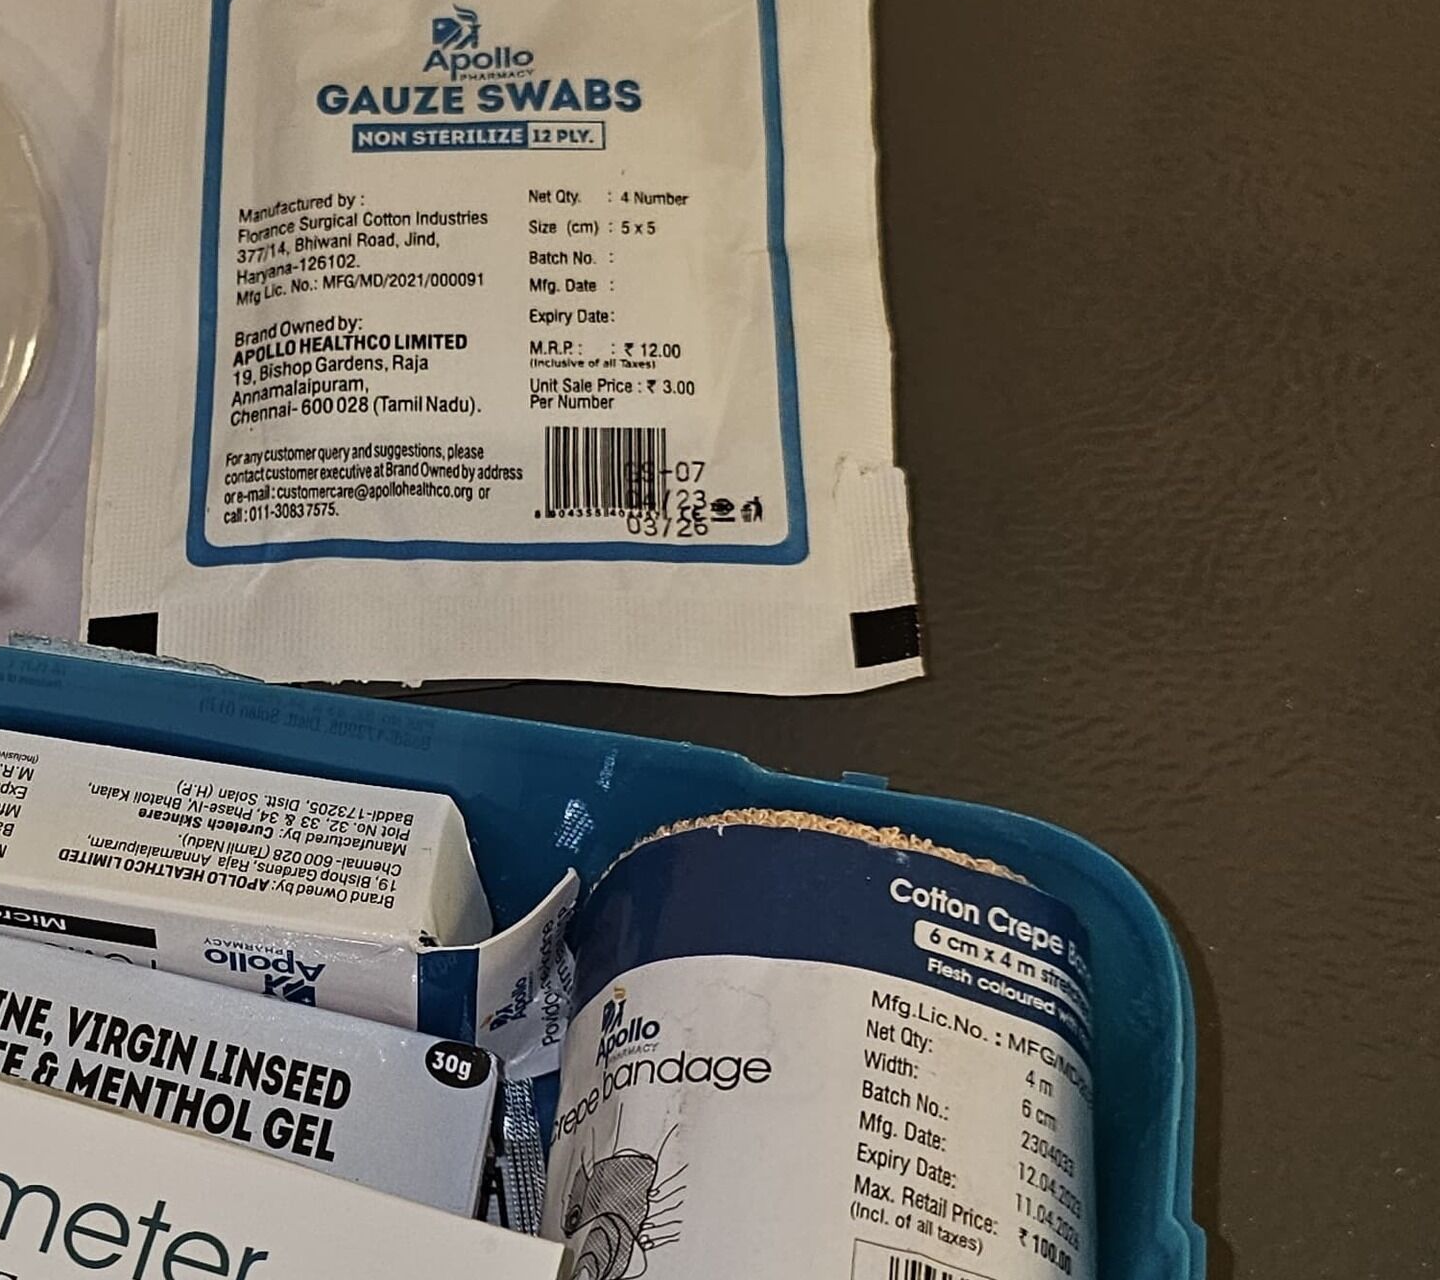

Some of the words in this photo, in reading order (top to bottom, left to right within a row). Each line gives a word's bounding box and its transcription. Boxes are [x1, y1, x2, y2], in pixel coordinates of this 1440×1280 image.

[423, 46, 534, 81] Apollo
[460, 69, 535, 81] PHARMACY
[316, 84, 464, 115] GAUZE
[477, 79, 642, 112] SWABS
[358, 130, 407, 147] NON
[412, 128, 524, 145] STERILIZE
[238, 194, 332, 223] Manufactured
[337, 193, 355, 209] by
[528, 189, 551, 203] Net
[634, 192, 689, 206] Number
[238, 222, 295, 243] Florance
[299, 213, 357, 231] Surgical
[362, 212, 411, 226] Cotton
[416, 210, 488, 226] Industries
[528, 220, 557, 234] Size
[567, 219, 599, 236] (cm)
[621, 221, 630, 234] 5
[647, 221, 656, 235] 5
[404, 232, 440, 248] Jind,
[529, 250, 568, 265] Batch
[323, 273, 484, 289] MFG/MD/2021/000091
[529, 279, 560, 294] Mfg.
[565, 279, 596, 292] Date
[529, 308, 572, 325] Expiry
[235, 325, 277, 347] Brand
[280, 316, 335, 337] Owned
[233, 339, 295, 367] APOLLO
[300, 334, 390, 353] HEALTHCO
[395, 334, 468, 350] LIMITED
[641, 343, 681, 358] 12.00
[260, 359, 311, 381] Bishop
[315, 355, 388, 373] Gardens,
[392, 355, 428, 373] Raja
[530, 378, 557, 393] Unit
[562, 378, 592, 393] Sale
[597, 379, 633, 393] Price
[663, 380, 695, 396] 3.00
[530, 395, 554, 410] Per
[558, 395, 615, 410] Number
[264, 447, 317, 462] customer
[386, 463, 419, 478] Brand
[421, 462, 459, 479] Owned
[461, 465, 476, 482] by
[477, 465, 523, 480] address
[218, 786, 259, 804] Solan
[138, 808, 202, 829] Skincare
[205, 818, 274, 839] Curetech
[285, 813, 297, 826] &
[300, 815, 319, 830] 33
[382, 826, 411, 841] Plot
[304, 834, 407, 856] Manufactured
[58, 848, 122, 869] LIMITED
[217, 856, 249, 873] Raja
[124, 856, 205, 883] HEALTHCO
[207, 871, 270, 891] APOLLO
[296, 883, 348, 903] Owned
[350, 888, 395, 908] Brand
[889, 877, 980, 925] Cotton
[987, 906, 1064, 955] Crepe
[930, 927, 942, 945] 6
[947, 935, 978, 958] cm
[1000, 952, 1012, 967] 4
[204, 945, 327, 982] Apollo
[927, 957, 973, 985] Flesh
[977, 976, 1056, 1016] coloured
[595, 1017, 661, 1068] Apollo
[866, 1019, 895, 1043] Net
[901, 1027, 934, 1053] Qty:
[1025, 1070, 1036, 1087] 4
[68, 1004, 194, 1077] VIRGIN
[202, 1040, 352, 1112] LINSEED
[429, 1048, 474, 1081] 30g
[864, 1049, 919, 1079] Width:
[602, 1050, 772, 1102] bandage
[862, 1080, 911, 1108] Batch
[68, 1059, 253, 1142] MENTHOL
[261, 1112, 336, 1164] GEL
[859, 1111, 897, 1139] Mfg.
[904, 1121, 946, 1152] Date:
[856, 1142, 911, 1175] Expiry
[916, 1157, 957, 1189] Date:
[853, 1174, 895, 1203] Max.
[901, 1186, 947, 1218] Retail
[951, 1203, 999, 1236] Price:
[895, 1213, 912, 1229] of
[916, 1218, 934, 1236] all
